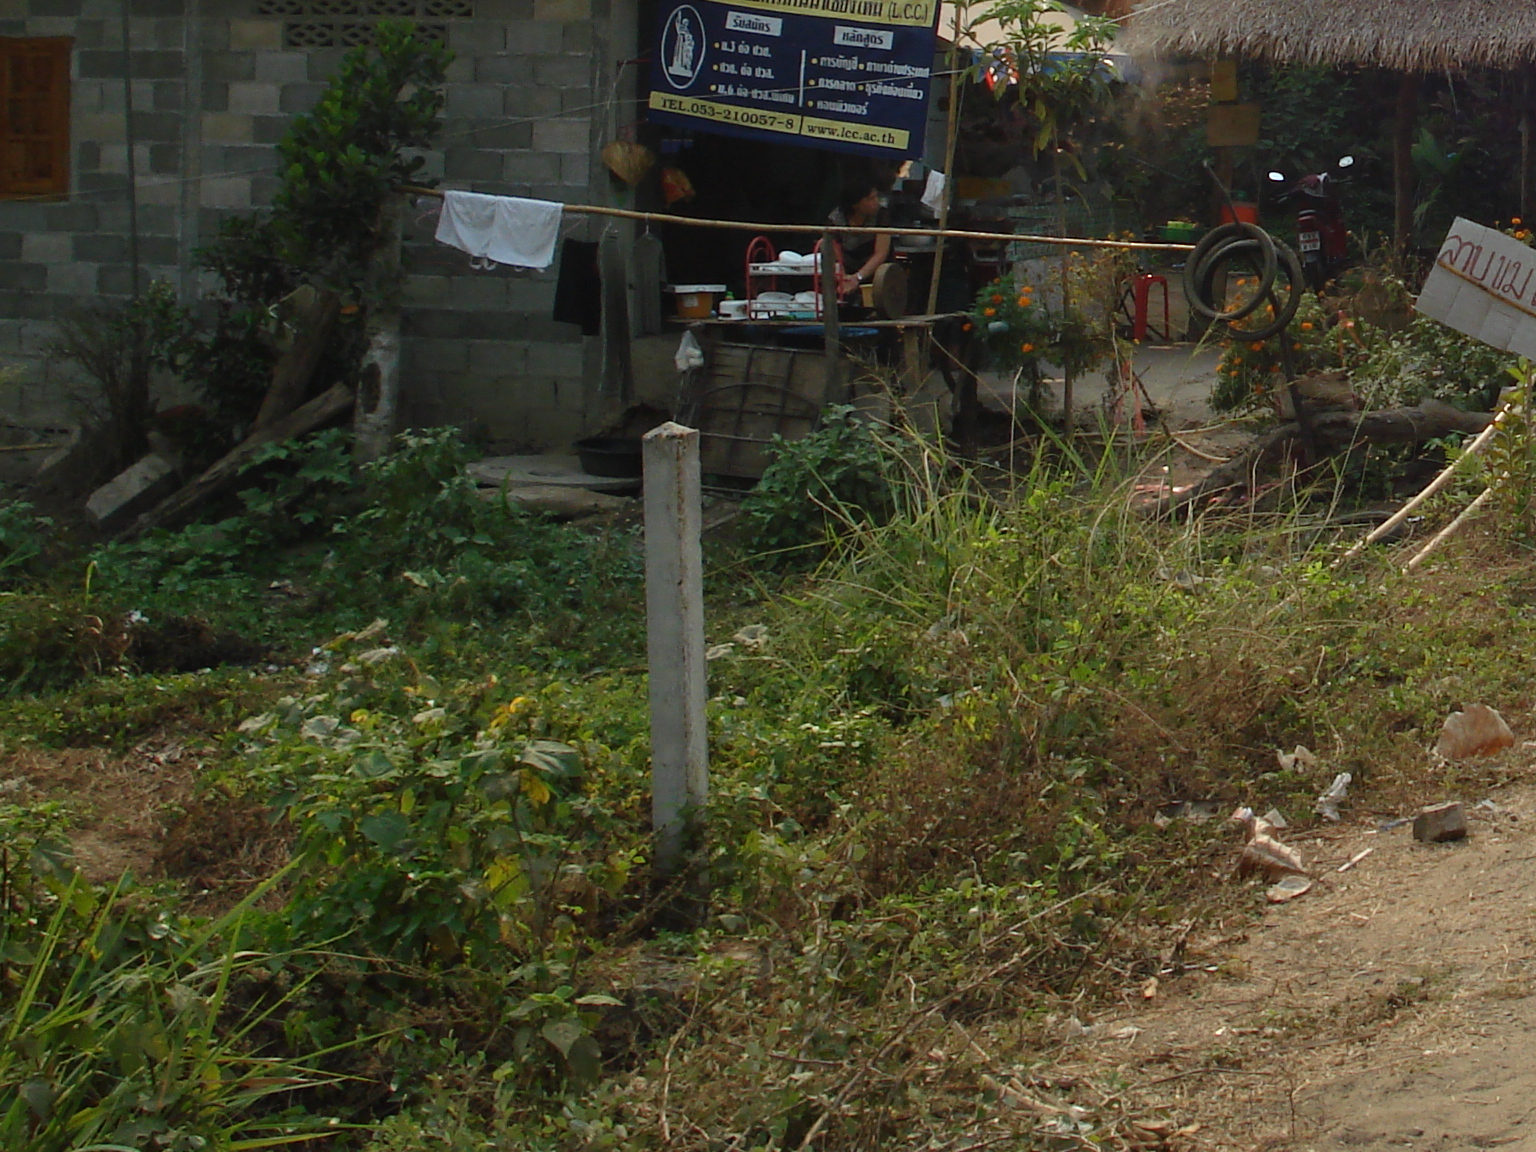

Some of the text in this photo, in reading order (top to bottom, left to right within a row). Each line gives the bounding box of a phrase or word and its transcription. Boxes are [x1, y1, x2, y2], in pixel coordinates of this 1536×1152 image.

[732, 15, 771, 32] รับสมัคร
[842, 29, 884, 48] หลักสูตร
[820, 54, 858, 71] การบัญชี
[661, 97, 794, 130] TEL.053-210057-8
[807, 123, 896, 145] www.lcc.ac.th
